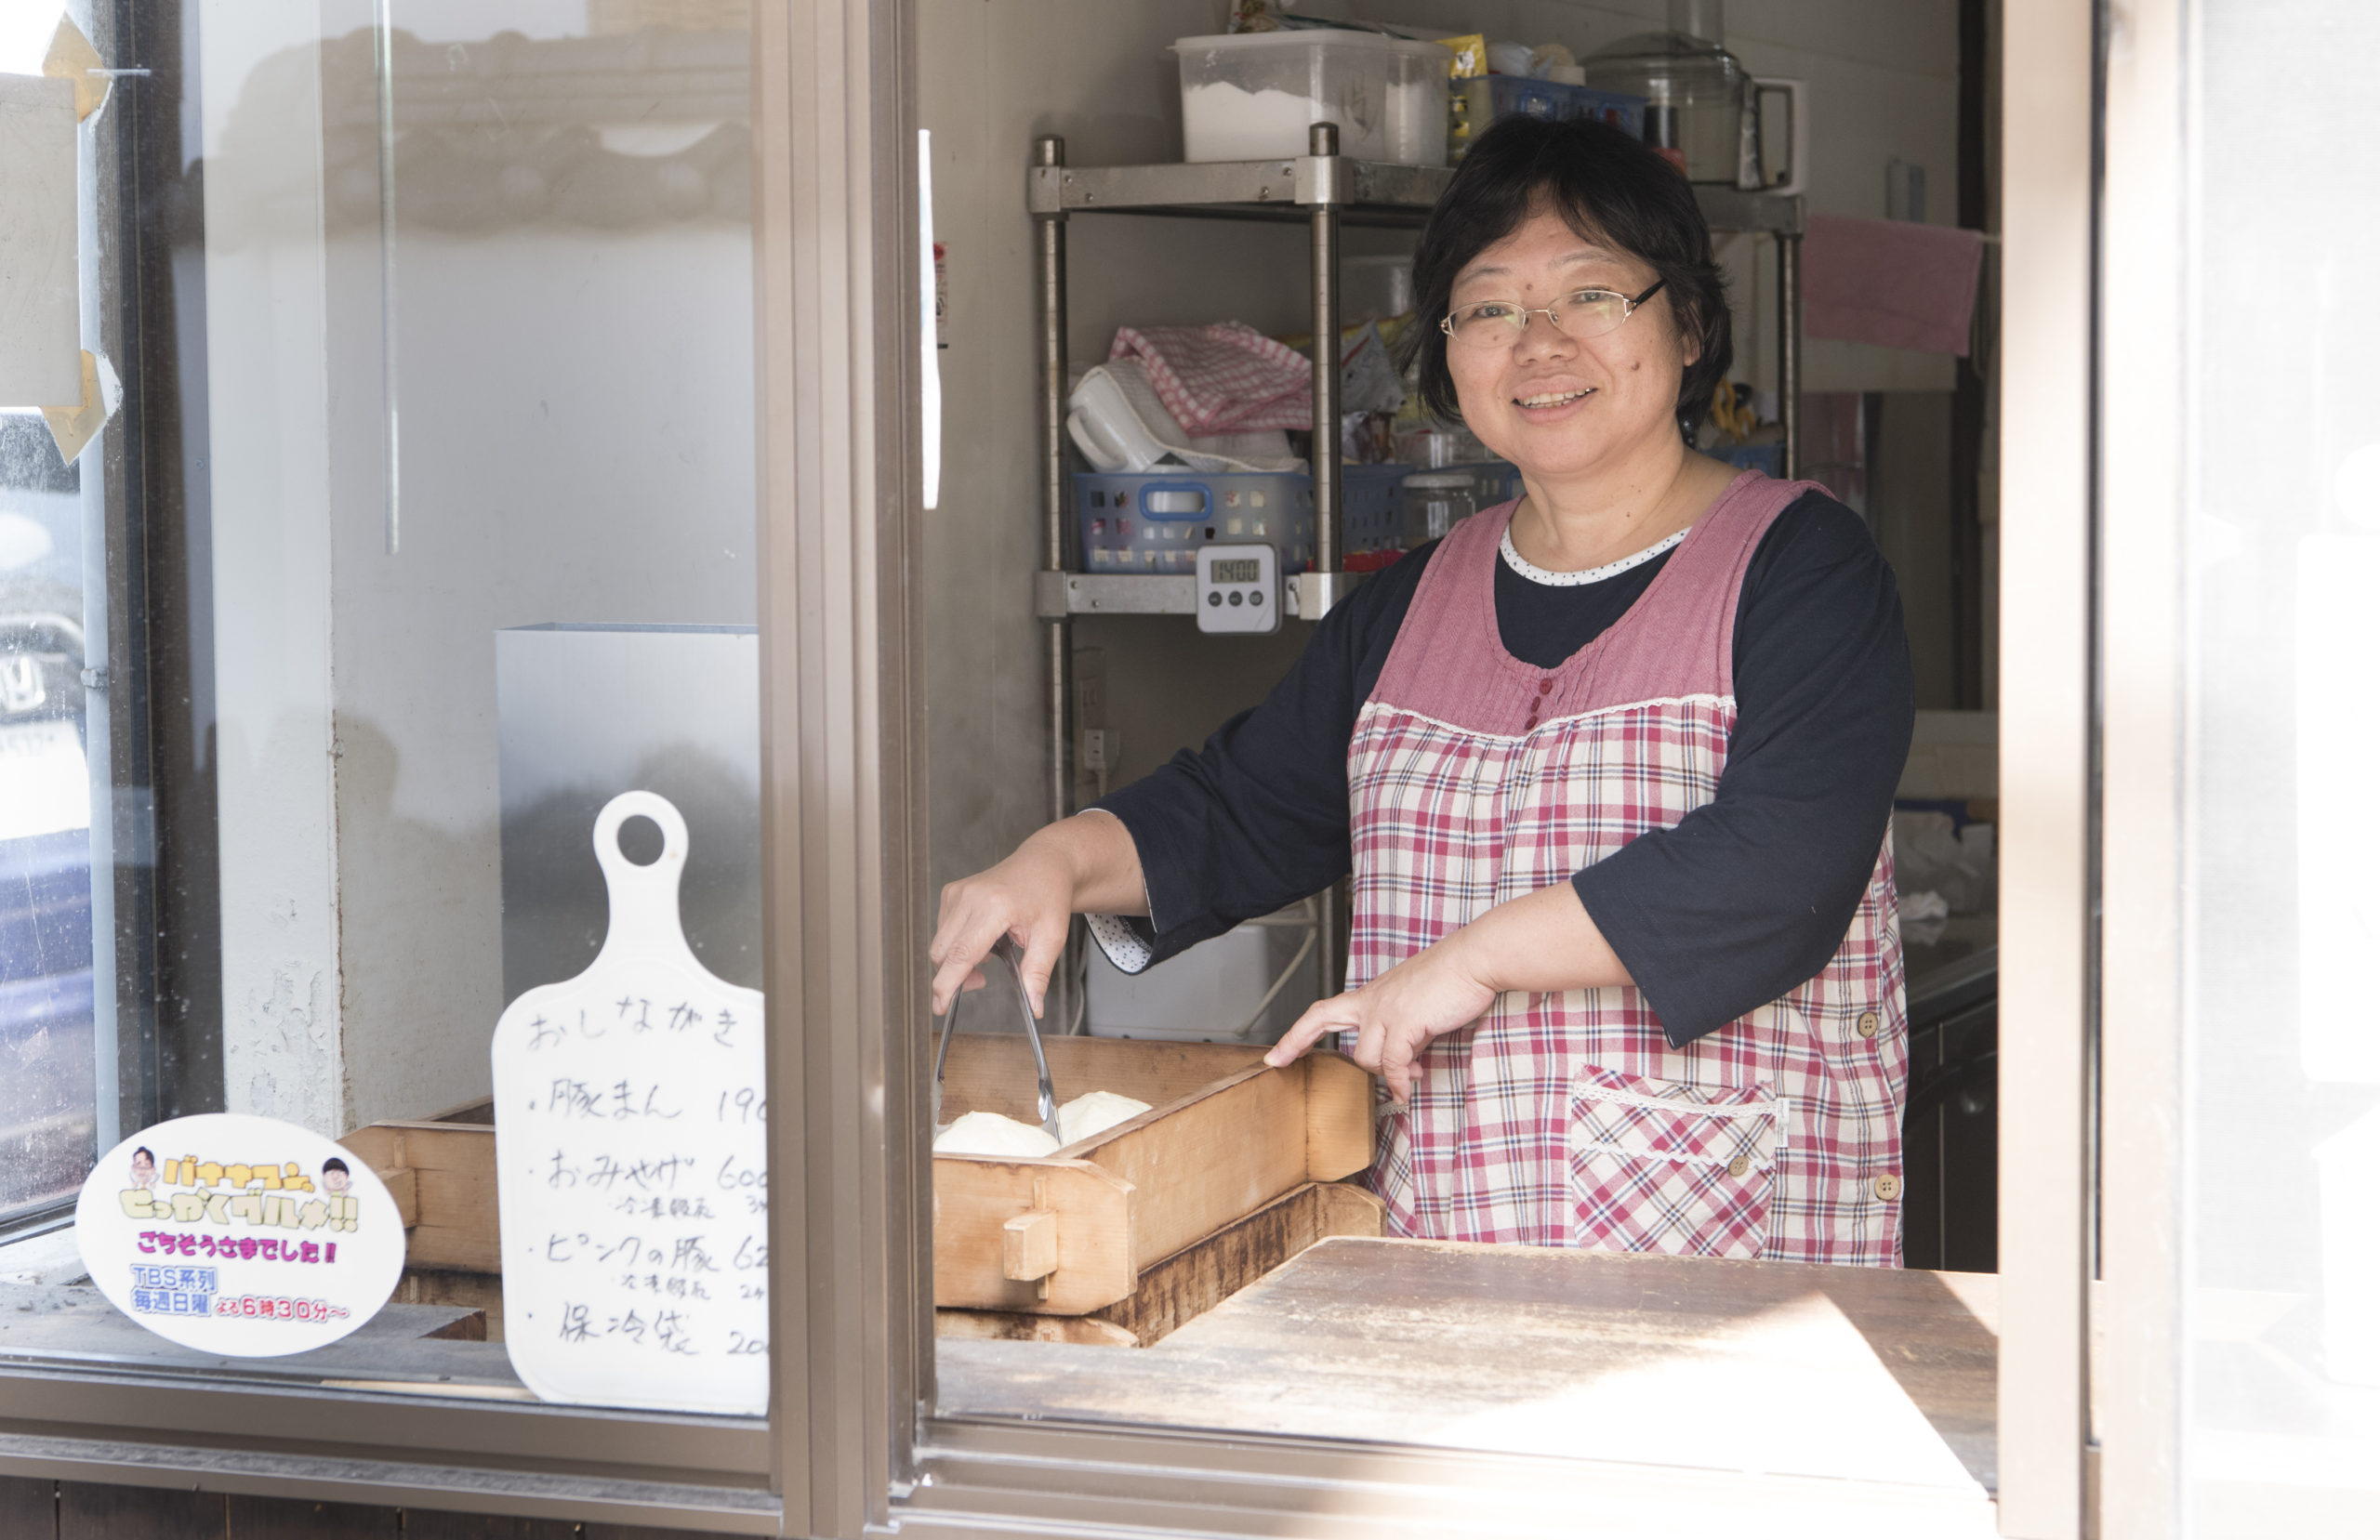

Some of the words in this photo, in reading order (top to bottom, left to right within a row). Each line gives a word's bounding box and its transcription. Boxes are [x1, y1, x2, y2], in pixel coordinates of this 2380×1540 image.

[528, 996, 737, 1051] おしながき
[549, 1078, 683, 1120] 豚まん
[549, 1150, 694, 1191] おみやげ
[547, 1233, 721, 1272] ピンクの豚
[132, 1266, 218, 1292] TBS系列
[133, 1289, 209, 1315] 毎週日曜
